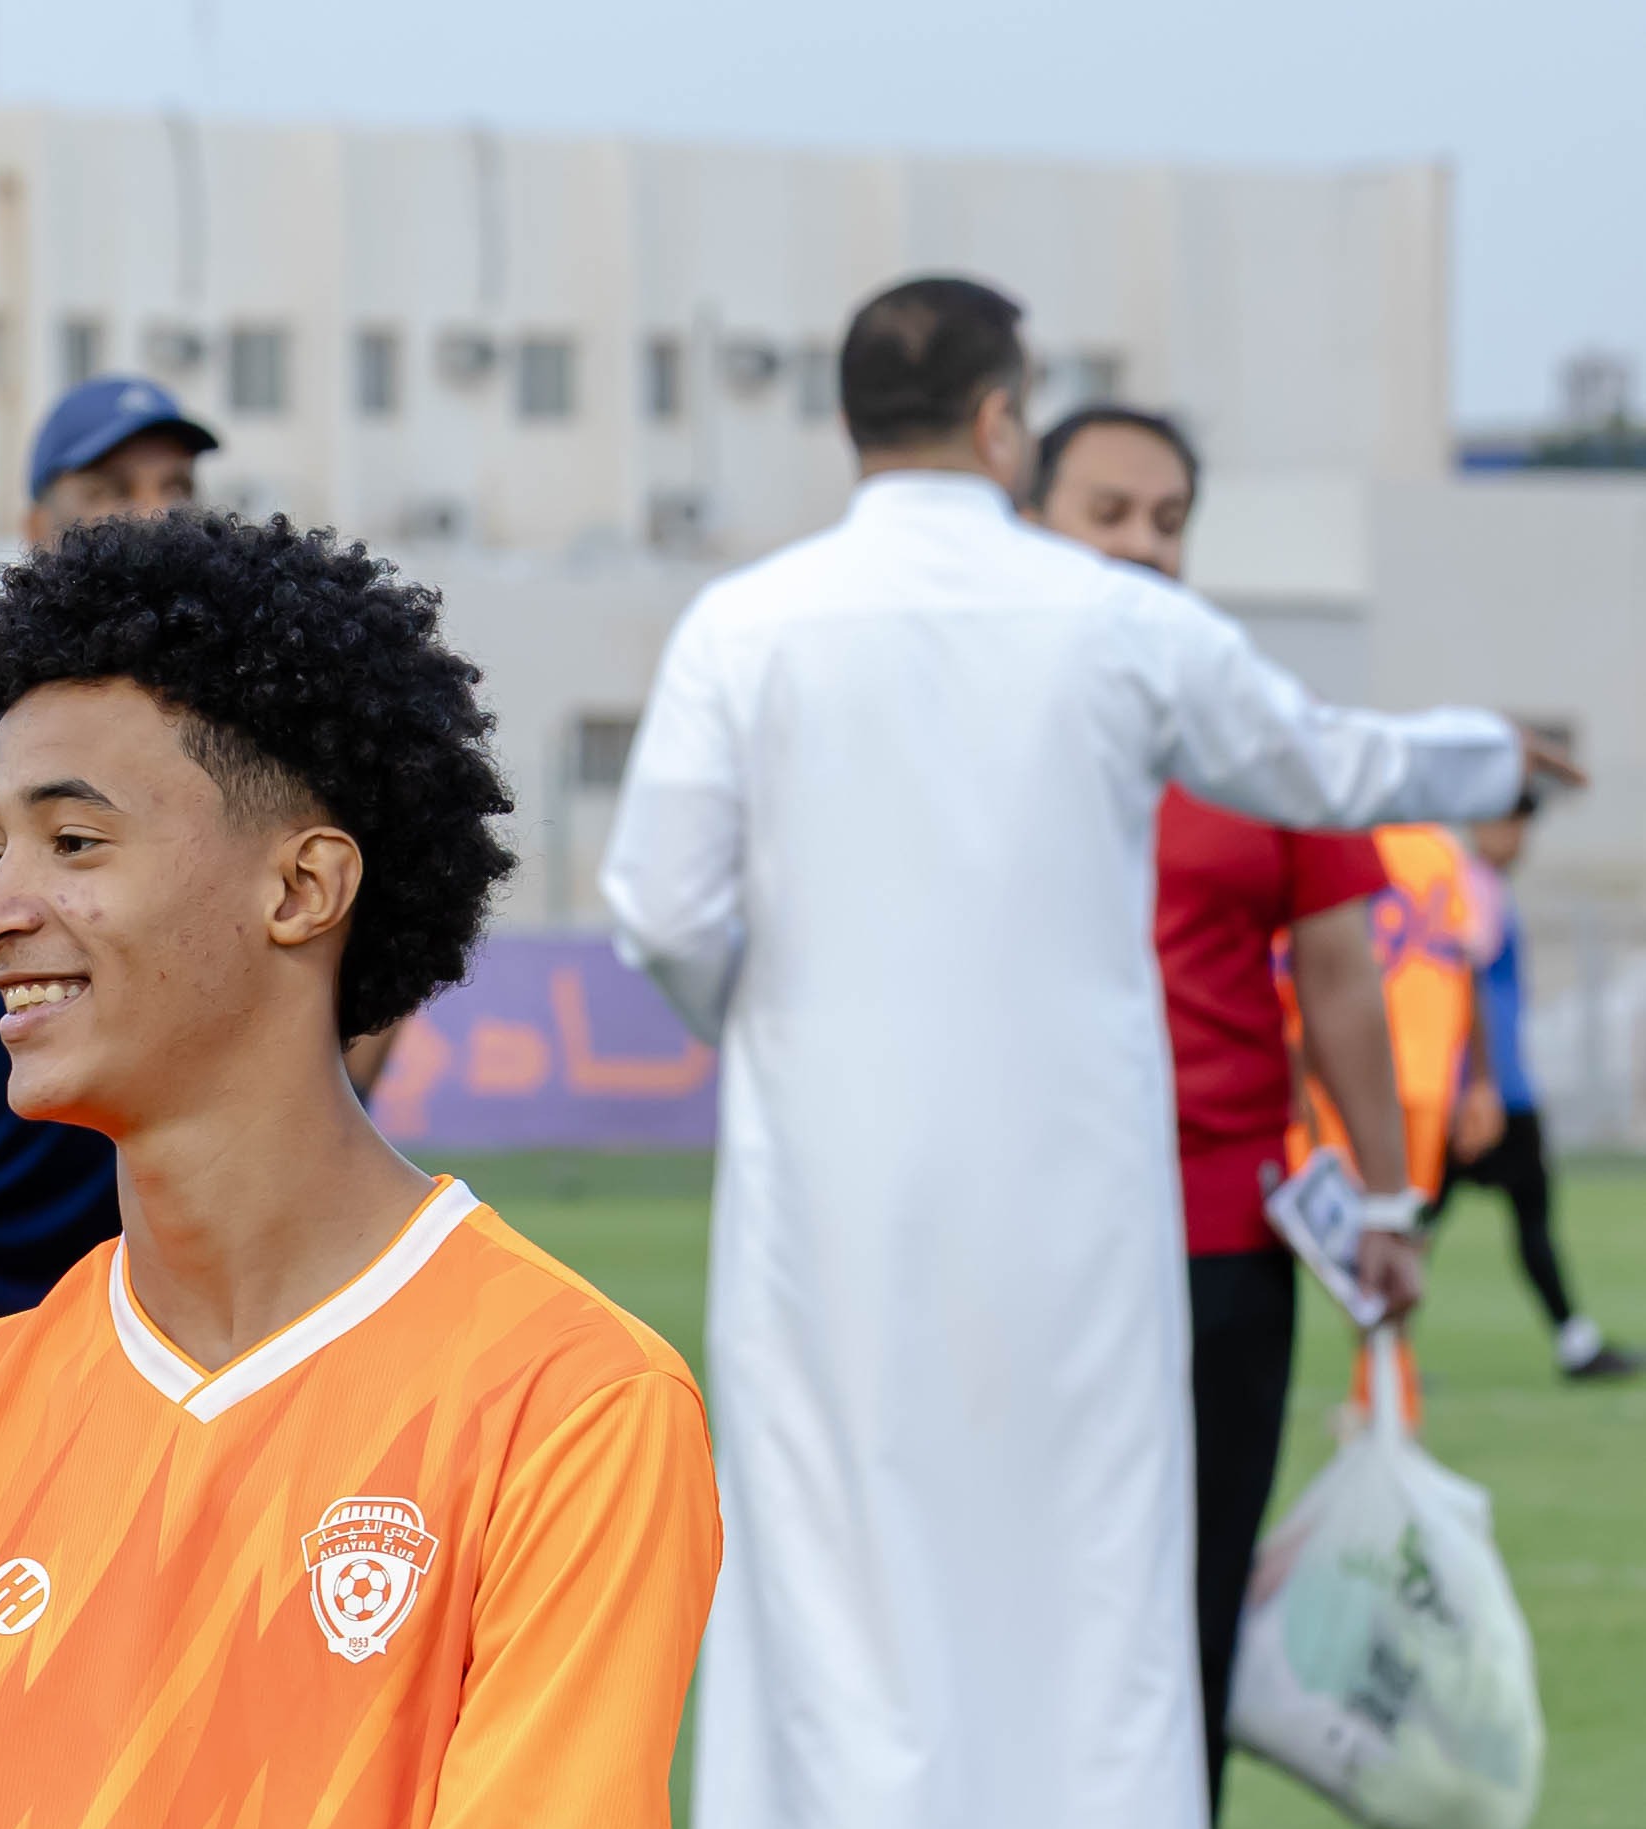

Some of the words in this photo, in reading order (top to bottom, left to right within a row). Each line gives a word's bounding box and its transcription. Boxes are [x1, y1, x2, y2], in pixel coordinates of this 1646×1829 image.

[318, 1520, 383, 1546] الفيحاء
[384, 1527, 425, 1547] نادي
[319, 1540, 376, 1561] ALFAYHA
[381, 1542, 415, 1561] CLUB
